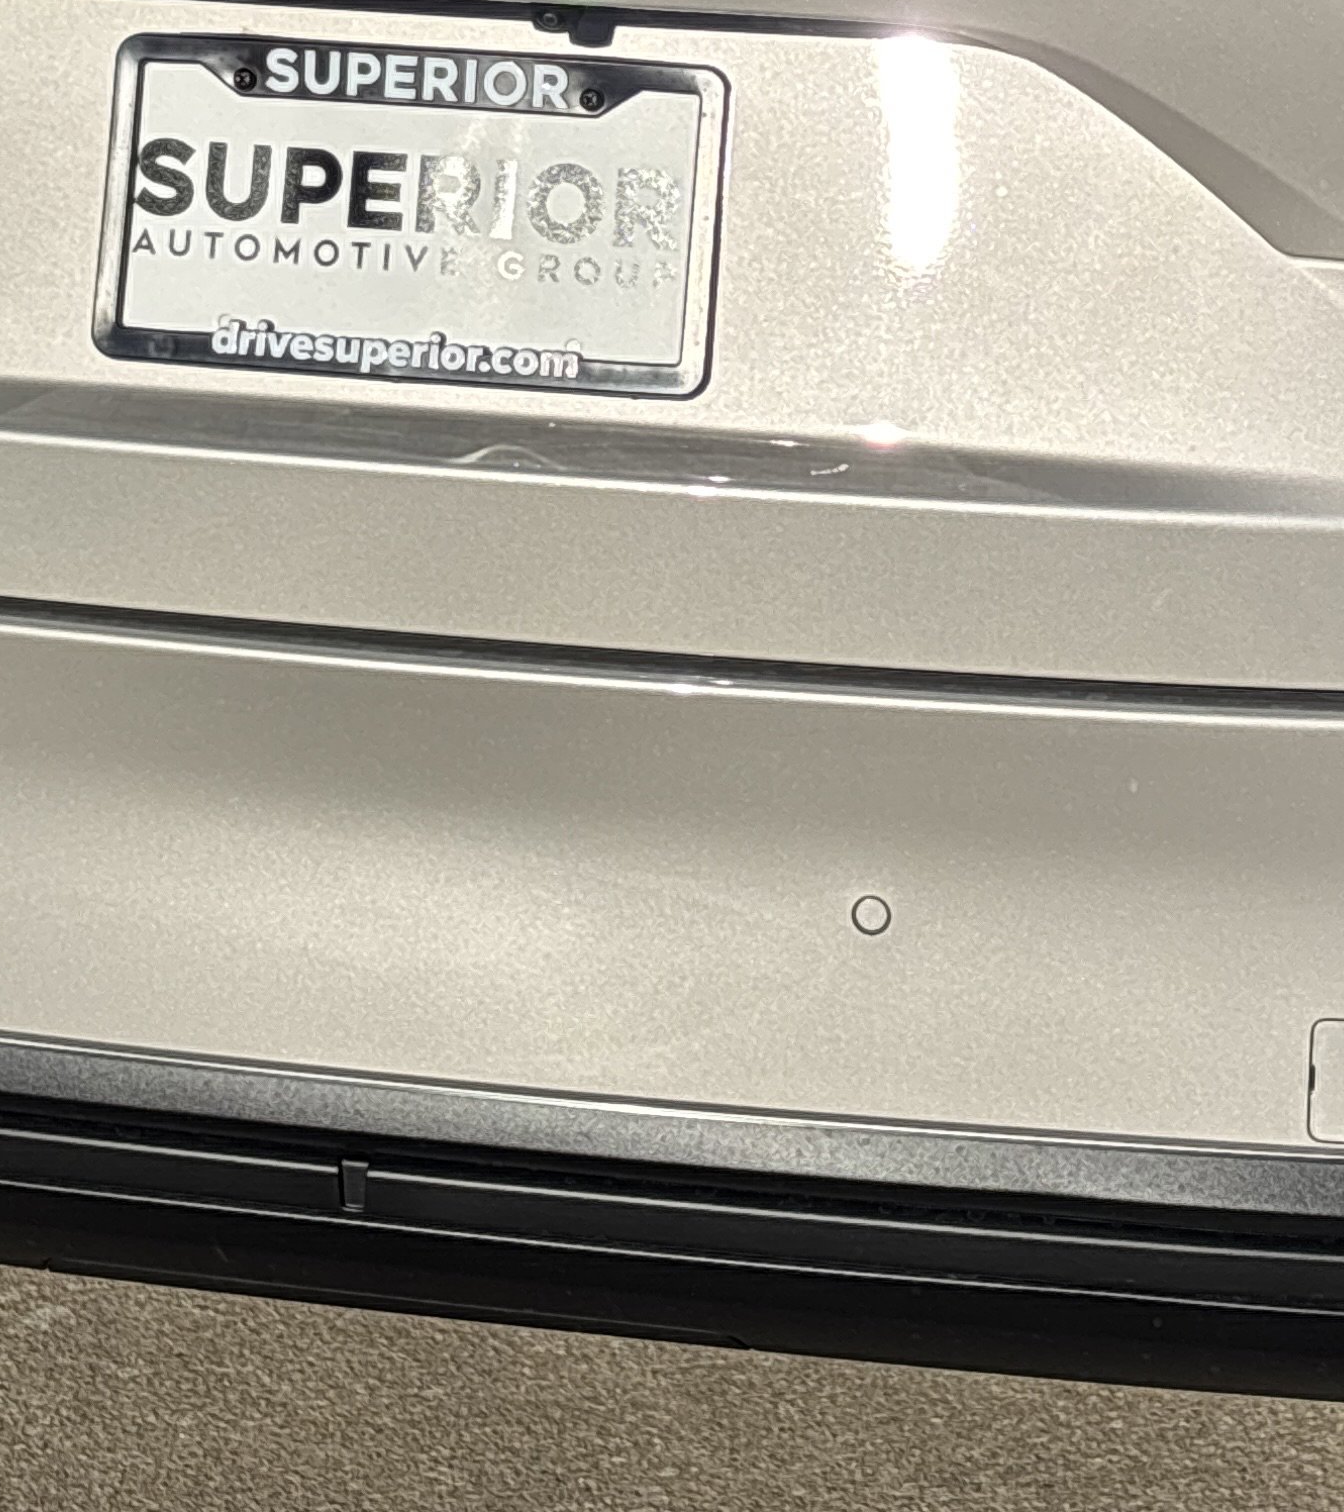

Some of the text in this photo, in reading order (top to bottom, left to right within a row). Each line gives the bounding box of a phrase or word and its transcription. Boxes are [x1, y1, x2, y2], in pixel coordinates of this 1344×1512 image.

[265, 48, 568, 109] SUPERIOR
[134, 137, 680, 251] SUPERIOR
[132, 228, 677, 288] AUTOMOTIVE GROUP
[211, 319, 580, 380] drivesuperior.com
